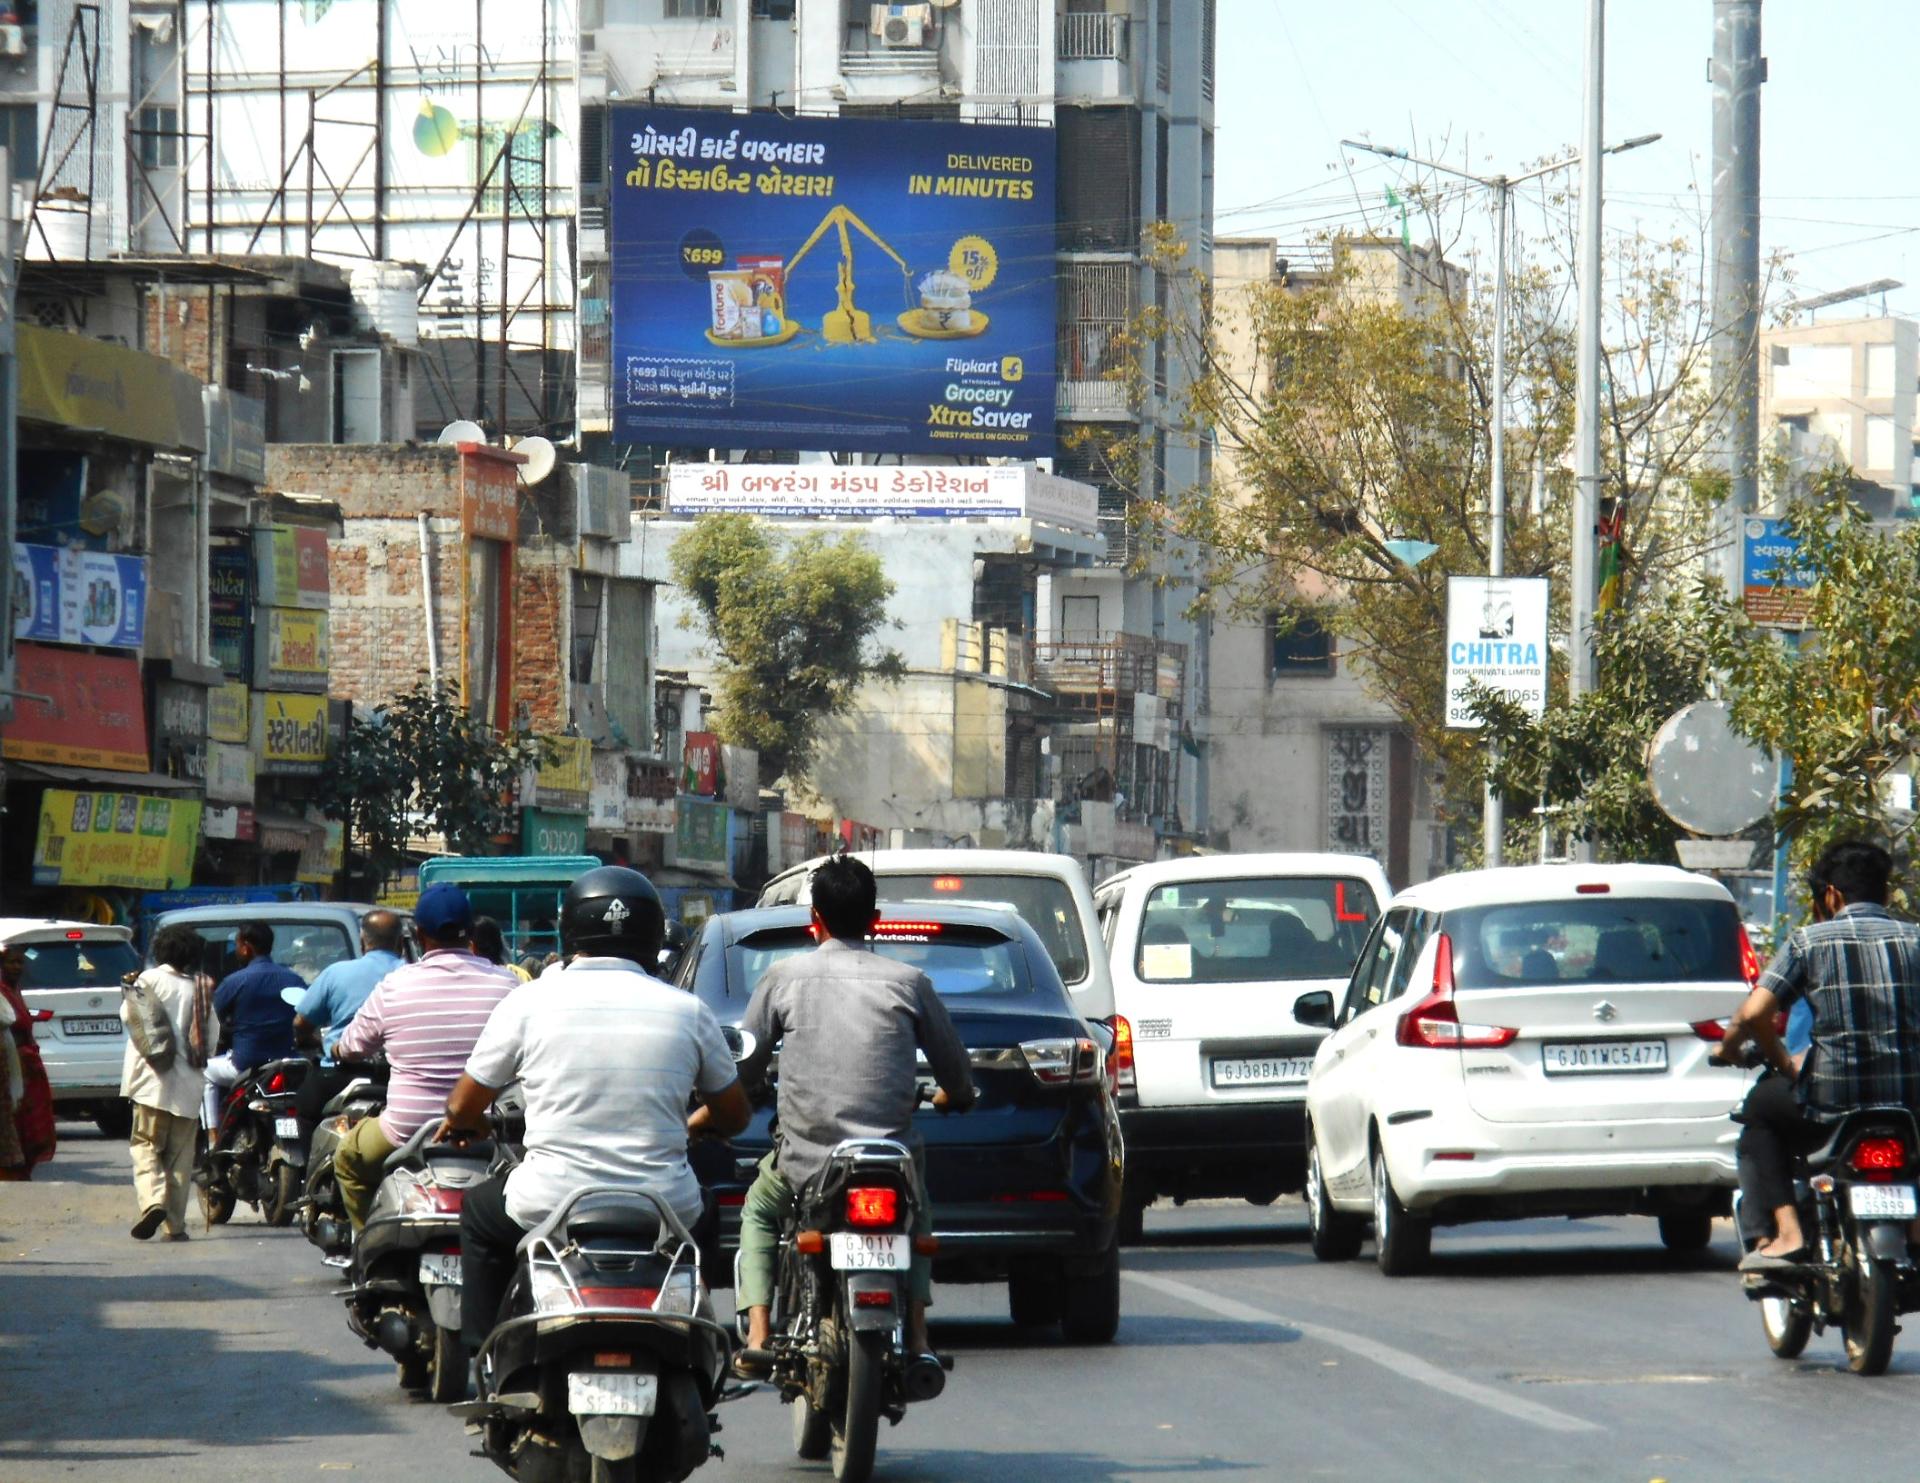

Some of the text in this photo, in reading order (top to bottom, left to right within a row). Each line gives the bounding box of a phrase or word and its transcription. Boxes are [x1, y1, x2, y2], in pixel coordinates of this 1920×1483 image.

[631, 124, 826, 164] ગ્રોસરી કાર્ટ વજનદાર
[947, 154, 1033, 172] DELIVERED
[626, 158, 835, 197] તો ડિસ્કાઉન્ટ જોરદાર!
[908, 175, 1034, 199] IN MINUTES
[962, 250, 989, 267] 15%
[945, 358, 998, 375] Flipkart
[945, 384, 1013, 406] Grocery
[928, 404, 1032, 428] XtraSaver
[929, 430, 959, 440] LOWEST
[960, 431, 984, 441] PRICES
[997, 433, 1029, 442] GROCERY
[701, 469, 729, 492] શ્રી
[742, 470, 818, 493] બજરંગ
[830, 471, 878, 493] મંડપ
[891, 470, 989, 494] ડેકોરેશન
[1451, 642, 1539, 665] CHITRA
[1472, 668, 1507, 677] PRIVATE
[1508, 669, 1541, 677] LIMITED
[267, 701, 325, 755] સ્ટેશનરી
[1336, 881, 1367, 921] L
[1558, 1046, 1663, 1066] GJ01WC5477
[846, 1236, 894, 1250] GJ01V
[846, 1252, 895, 1267] N3760
